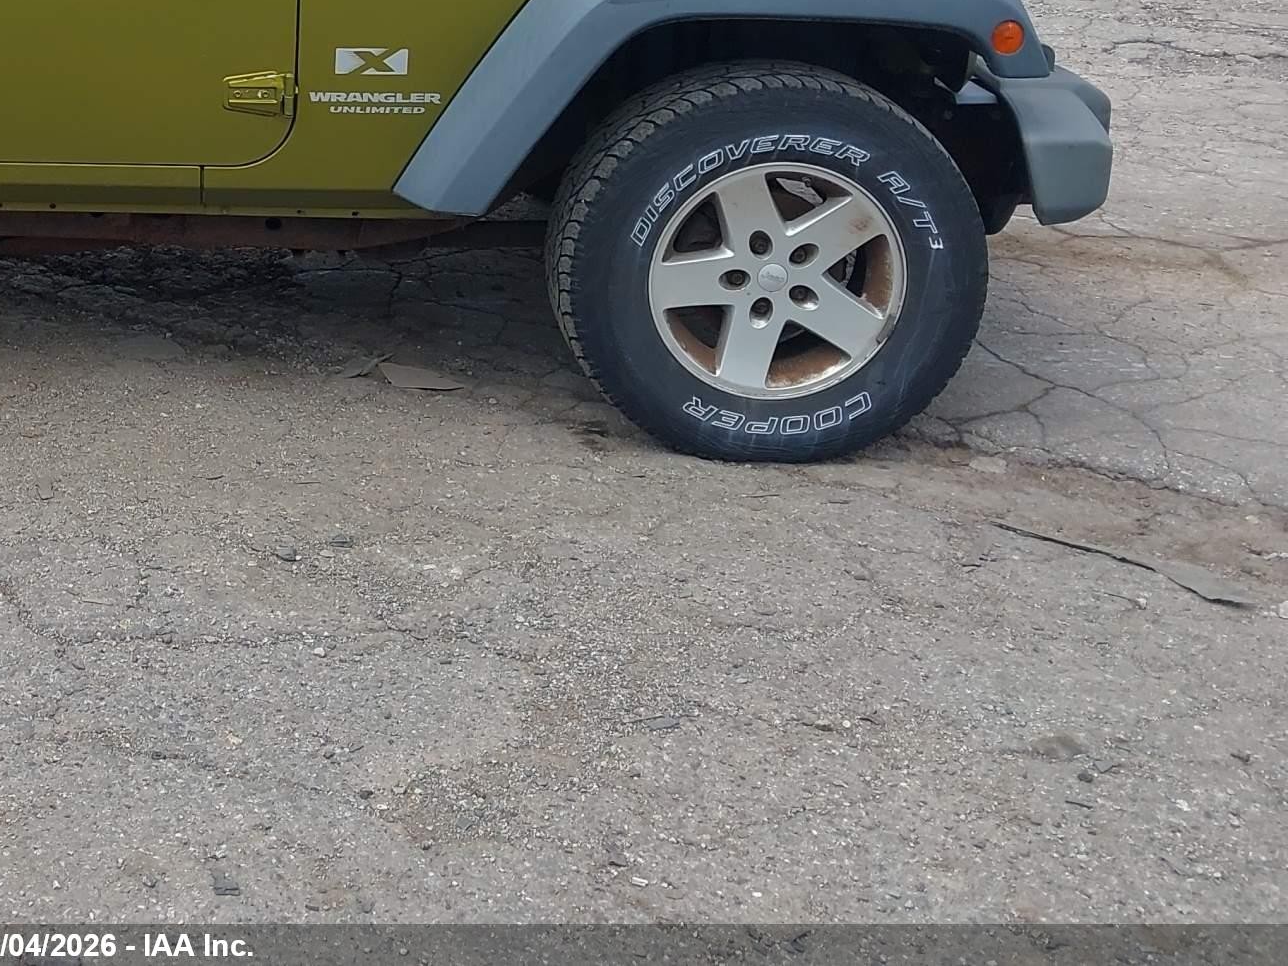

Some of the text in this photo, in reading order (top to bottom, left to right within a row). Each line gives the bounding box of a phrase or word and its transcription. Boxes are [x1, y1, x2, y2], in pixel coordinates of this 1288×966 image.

[309, 91, 441, 104] WRANGLER
[330, 105, 426, 114] UNLIMITED
[629, 134, 871, 248] DISCOVERER
[681, 390, 872, 436] COOPER
